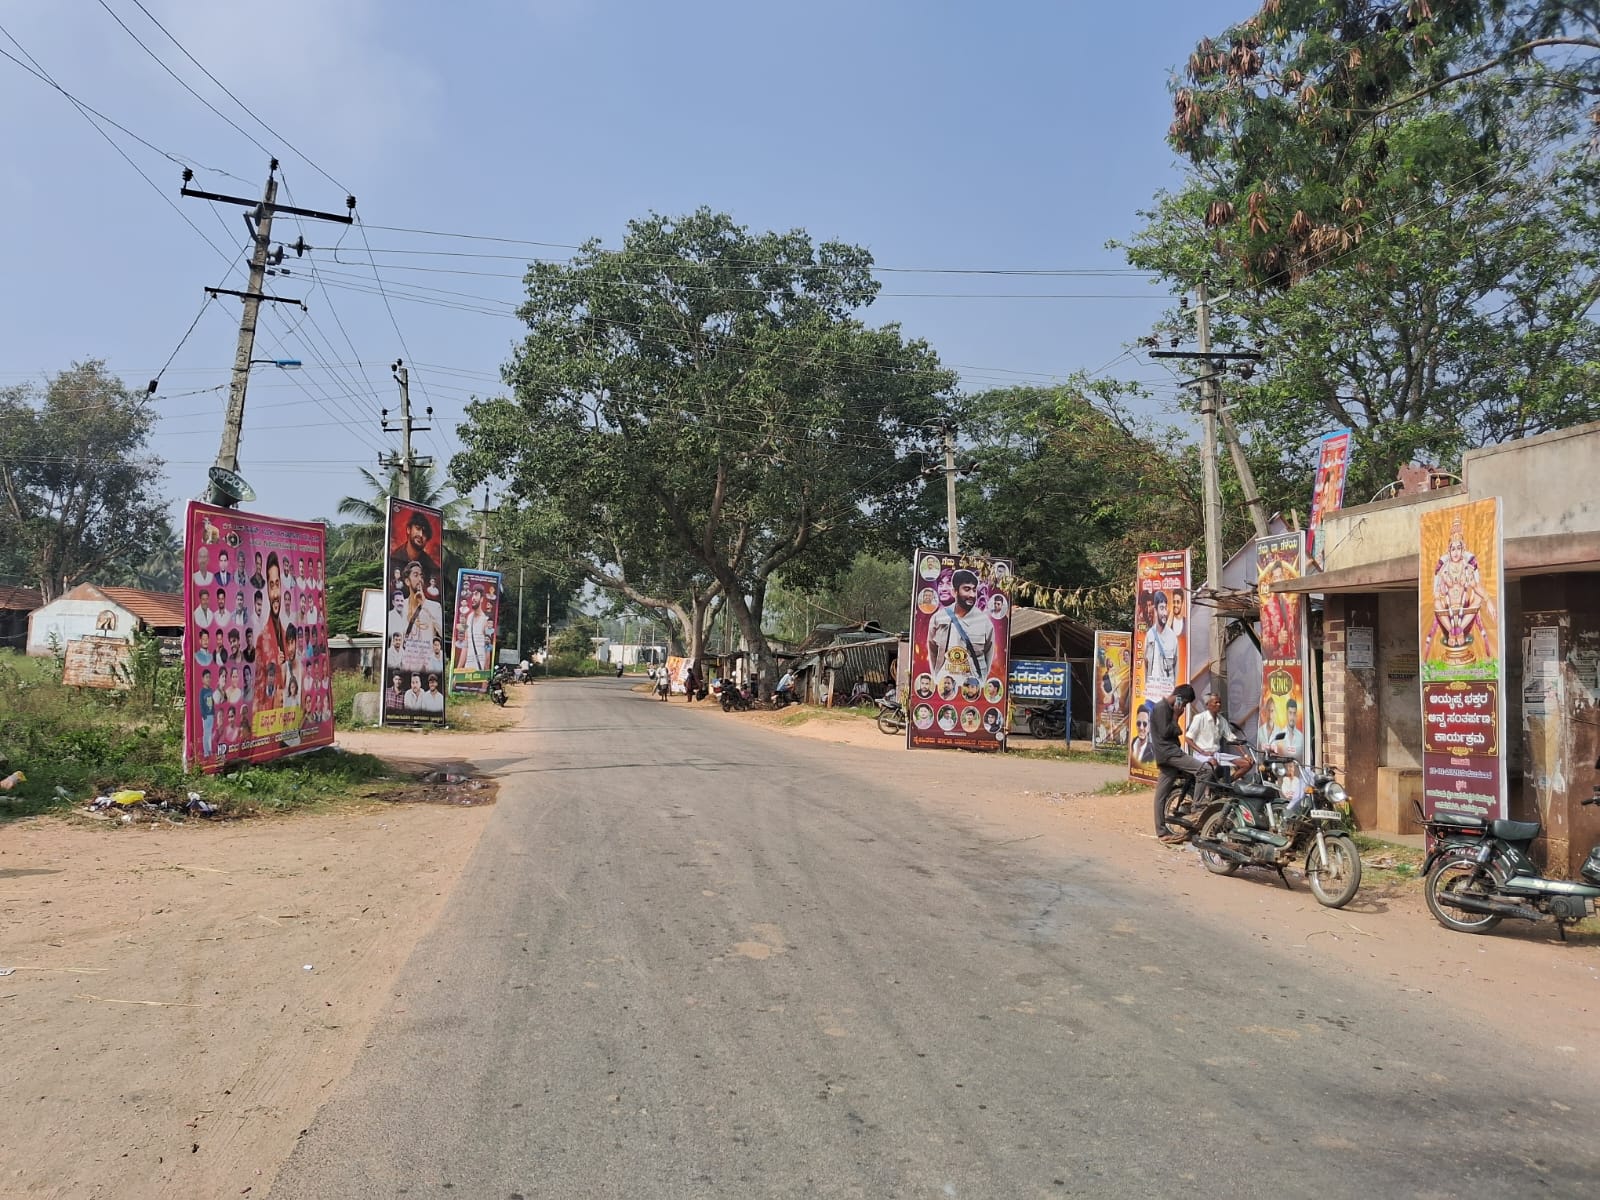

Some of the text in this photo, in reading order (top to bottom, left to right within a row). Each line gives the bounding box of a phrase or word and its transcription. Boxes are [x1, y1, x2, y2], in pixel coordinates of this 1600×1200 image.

[1430, 692, 1488, 709] ಅಯ್ಯಪ್ಪ ಭಕ್ತರ
[1428, 712, 1447, 727] ಅನ್ನ
[1434, 732, 1485, 745] ಕಾರ್ಯಕ್ರಮ
